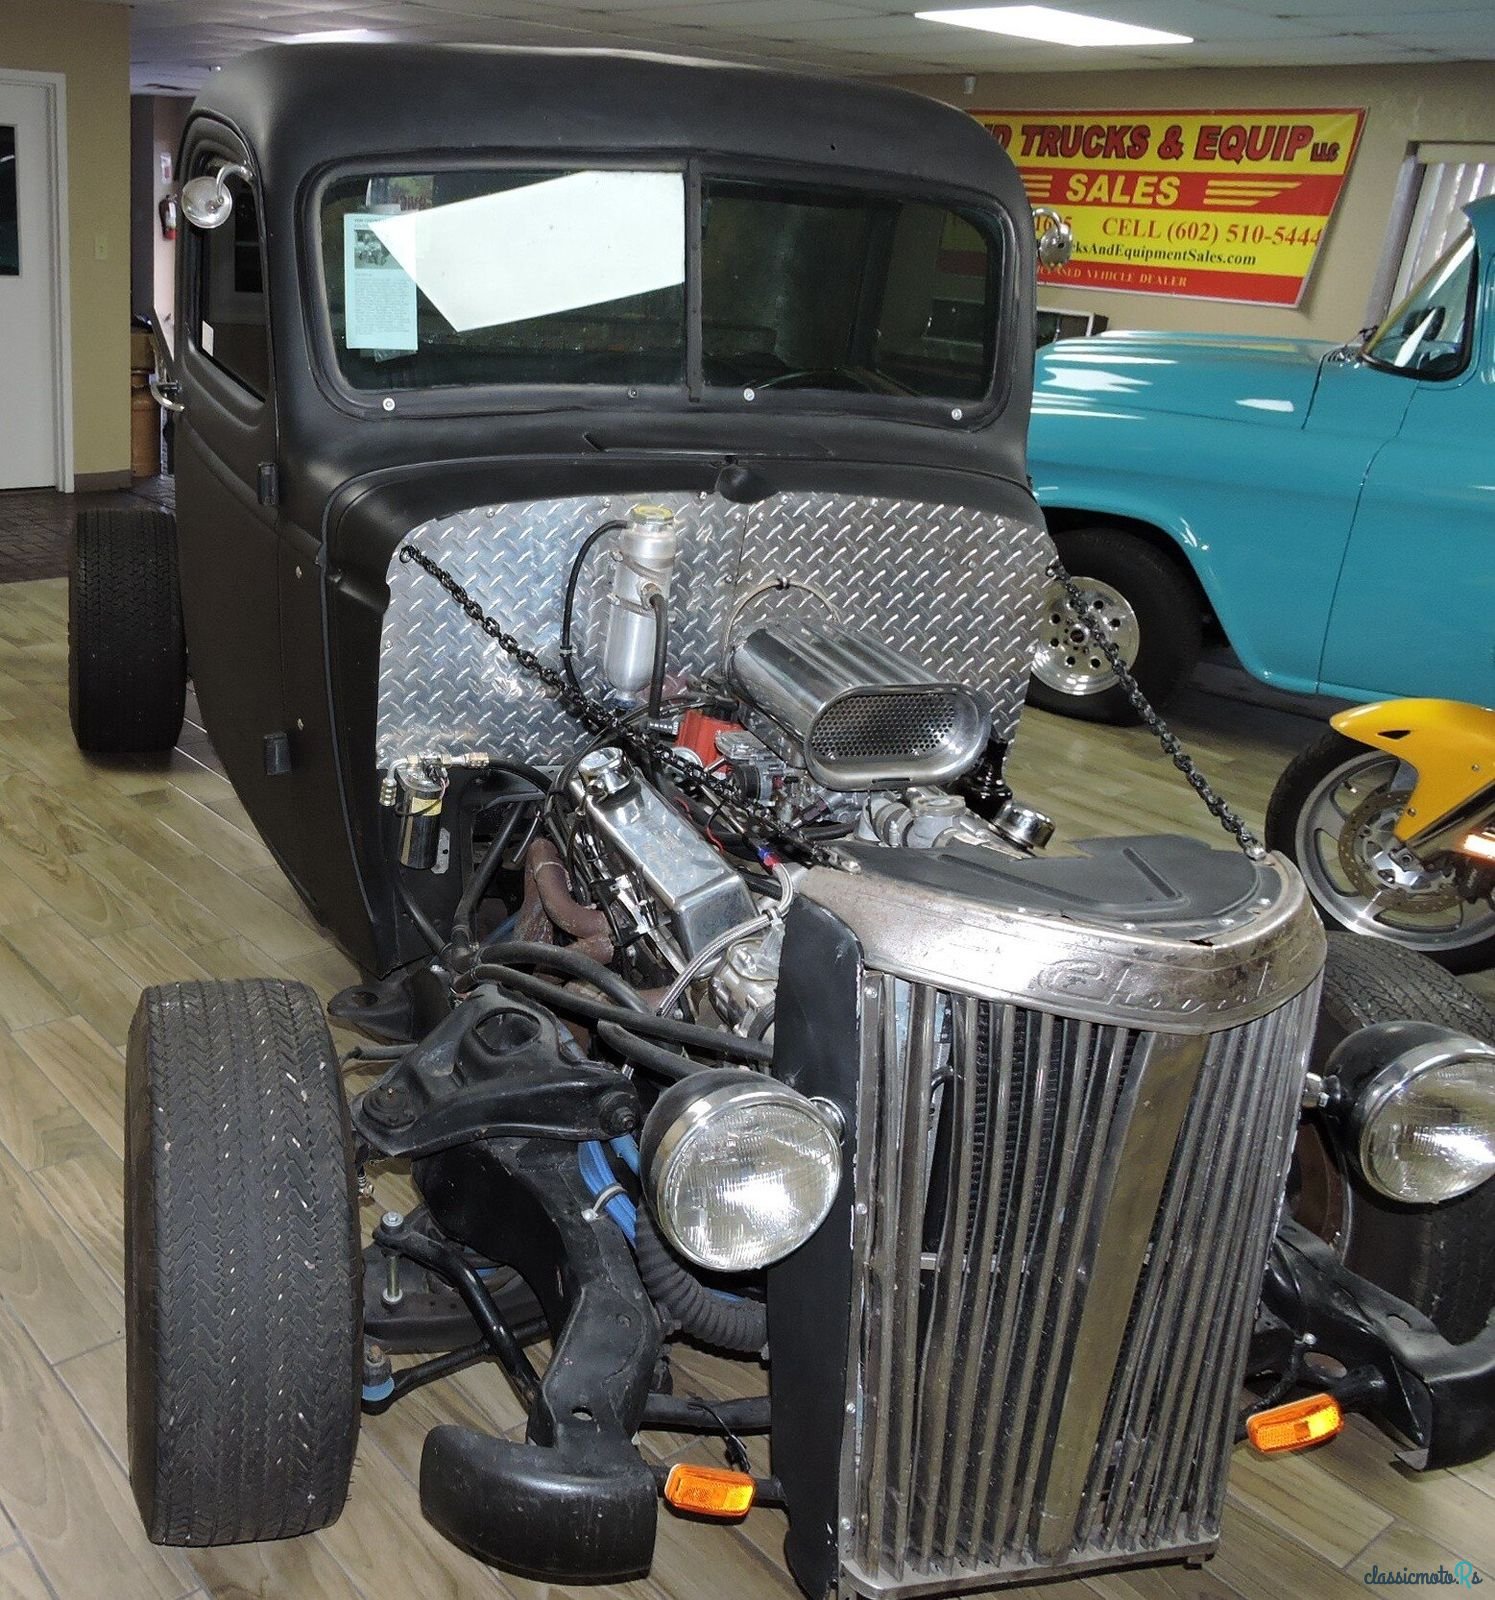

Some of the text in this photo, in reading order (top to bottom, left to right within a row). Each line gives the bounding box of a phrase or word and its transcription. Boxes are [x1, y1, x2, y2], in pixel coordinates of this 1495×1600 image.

[1020, 124, 1151, 160] TRUCKS
[1157, 125, 1184, 161] &
[1194, 124, 1315, 165] EQUIP
[1310, 142, 1340, 162] LLC
[1066, 173, 1181, 206] SALES
[1102, 217, 1161, 239] CELL
[1167, 221, 1219, 245] (602)
[1226, 223, 1323, 247] 510-5444
[1087, 269, 1135, 282] VEHICLE
[1139, 273, 1188, 287] DEALER
